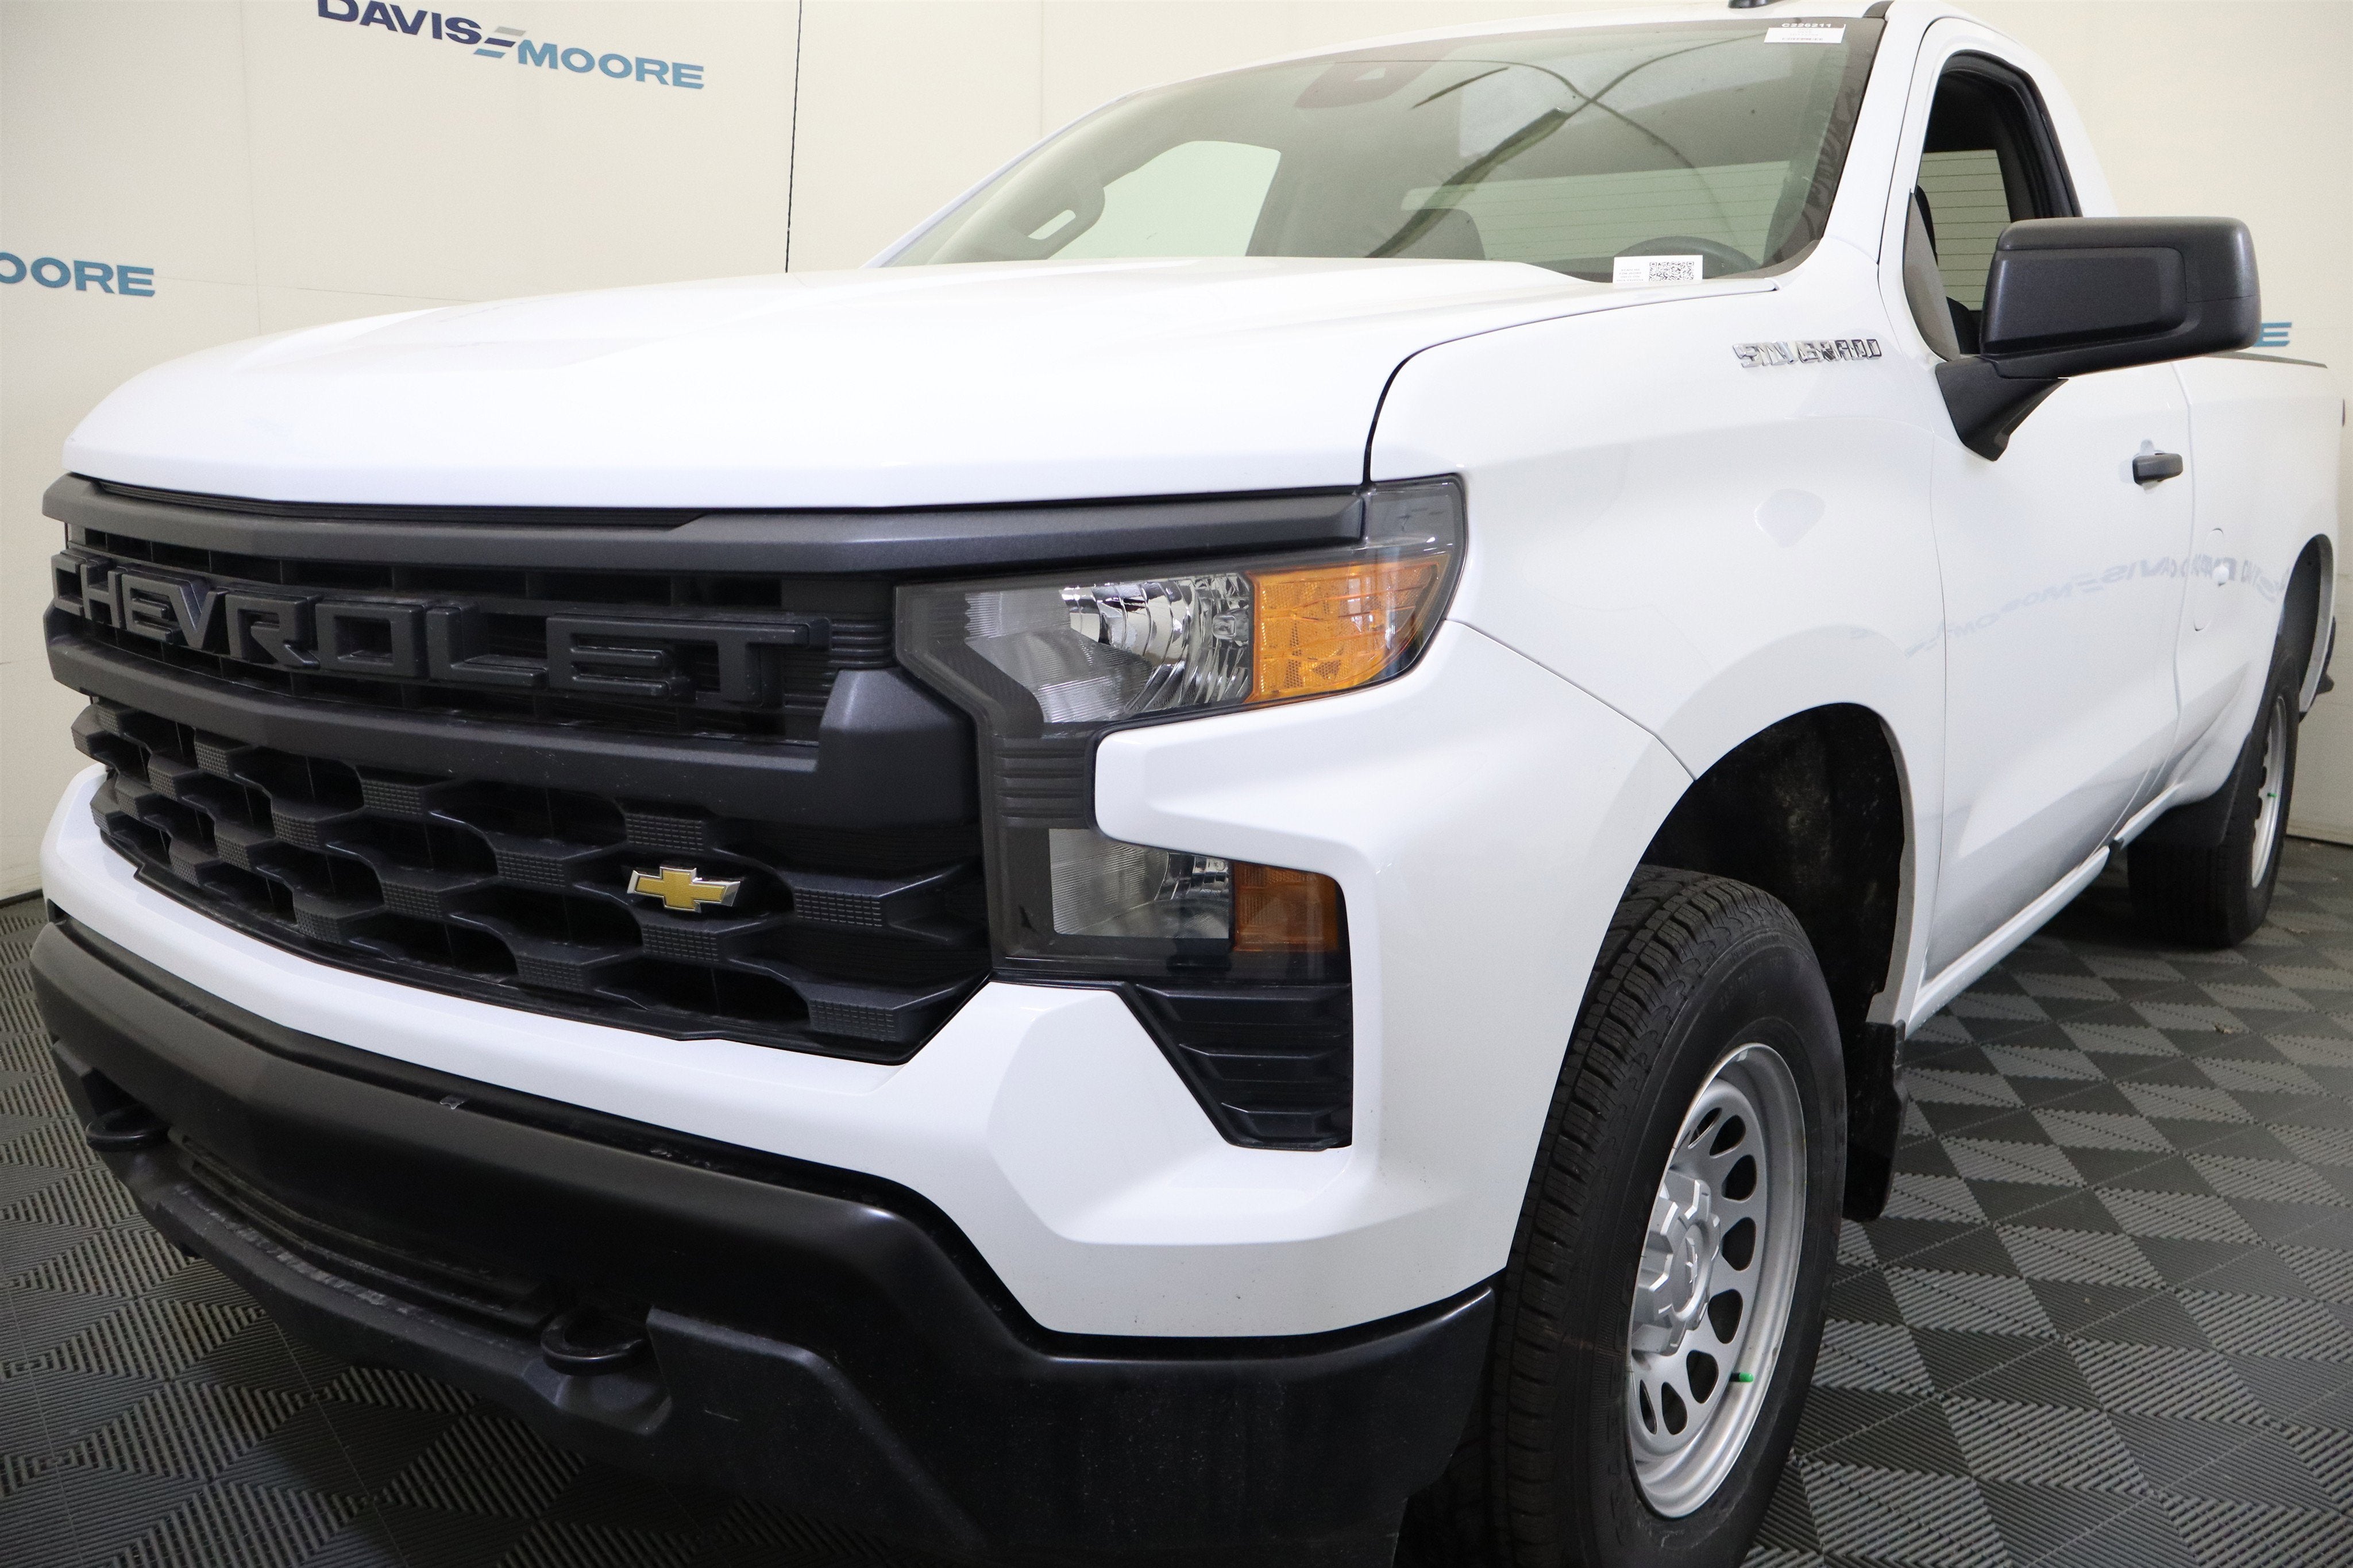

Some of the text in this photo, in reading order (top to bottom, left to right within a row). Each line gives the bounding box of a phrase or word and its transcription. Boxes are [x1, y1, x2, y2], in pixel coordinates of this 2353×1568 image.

[318, 0, 704, 89] DAVIS MOORE
[51, 549, 832, 709] CHEVROLET
